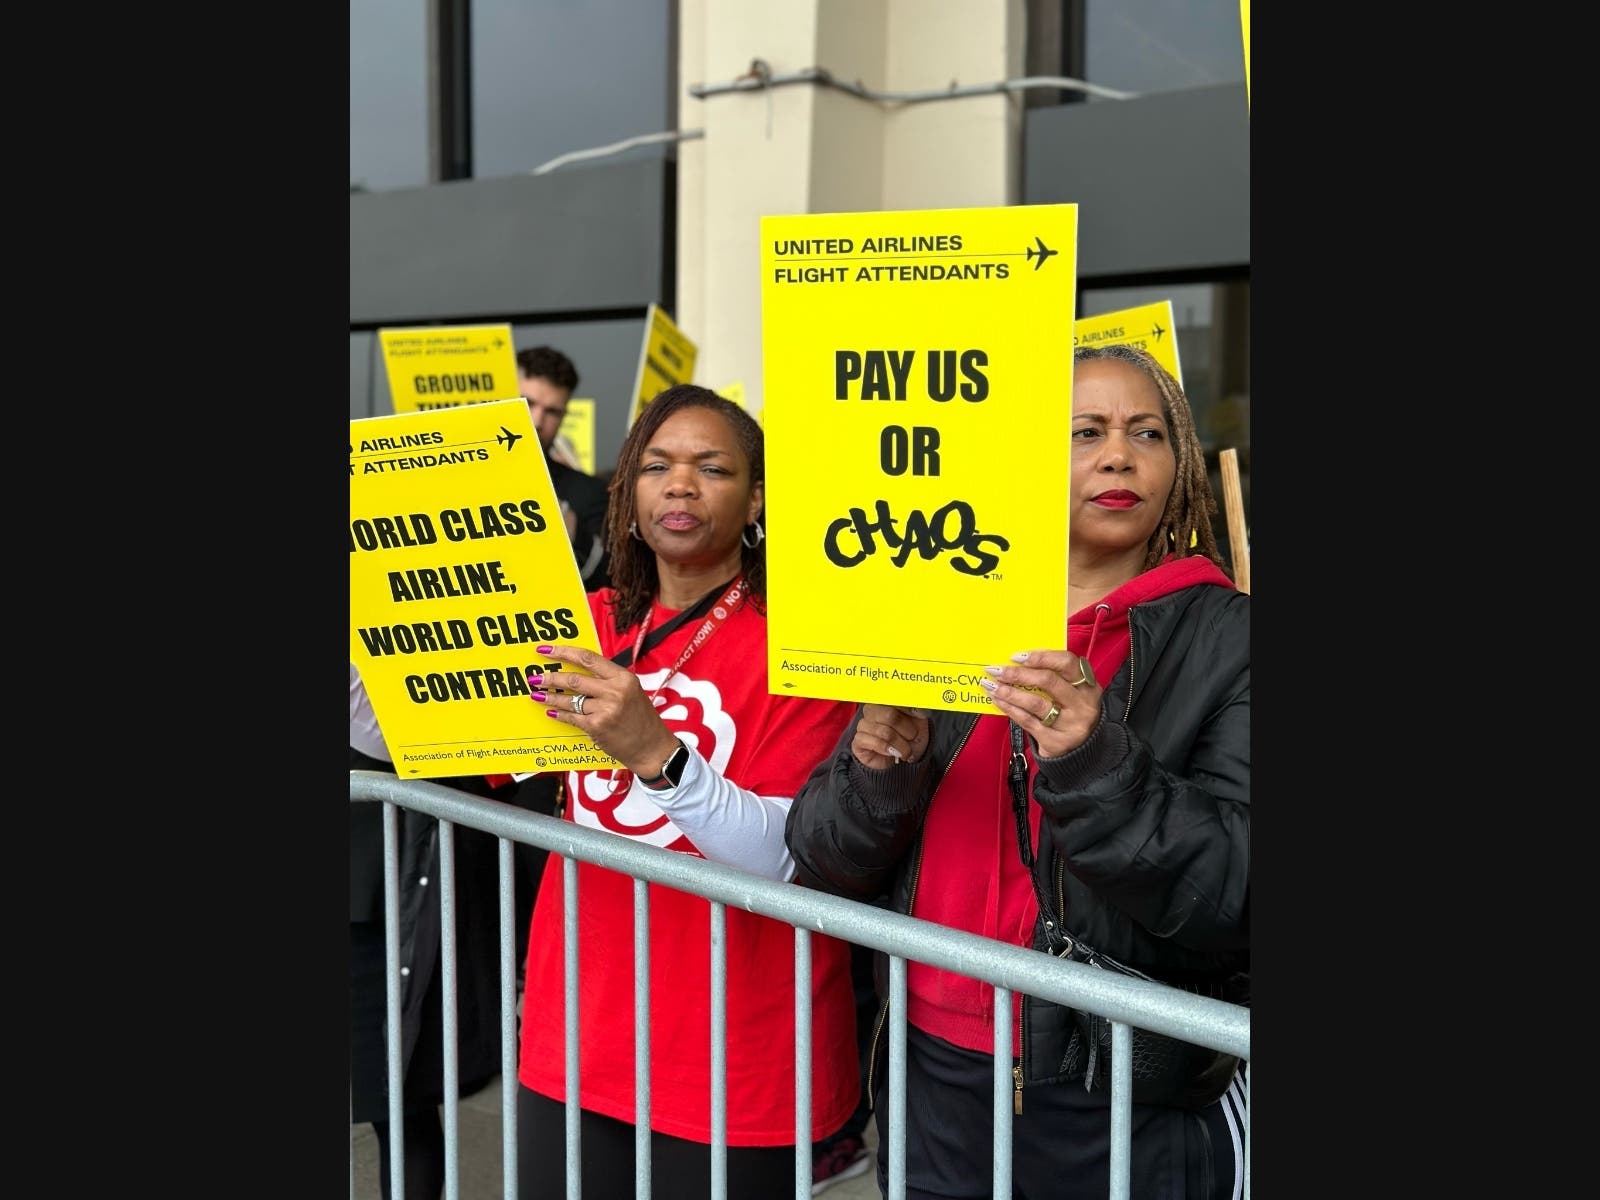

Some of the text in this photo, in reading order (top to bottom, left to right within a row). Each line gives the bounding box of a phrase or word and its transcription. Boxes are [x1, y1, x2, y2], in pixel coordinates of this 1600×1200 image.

[775, 235, 963, 256] UNITED AIRLINES
[775, 263, 1010, 283] FLIGHT ATTENDANTS
[414, 373, 495, 394] GROUND
[835, 349, 989, 402] PAY US
[360, 432, 444, 453] AIRLINES
[880, 424, 940, 476] OR
[363, 448, 489, 475] ATTENDANTS
[439, 499, 547, 542] CLASS
[823, 499, 1011, 577] CHAOS
[387, 560, 517, 603] AIRLINE,
[725, 590, 740, 606] NO
[357, 607, 579, 657] WORLD CLASS
[693, 620, 714, 647] NOW!
[781, 659, 987, 686] Association of Flight Attendants-CW
[403, 751, 453, 762] Association
[455, 749, 465, 758] of
[466, 748, 491, 759] Flight
[548, 755, 617, 765] UnitedAFA.org
